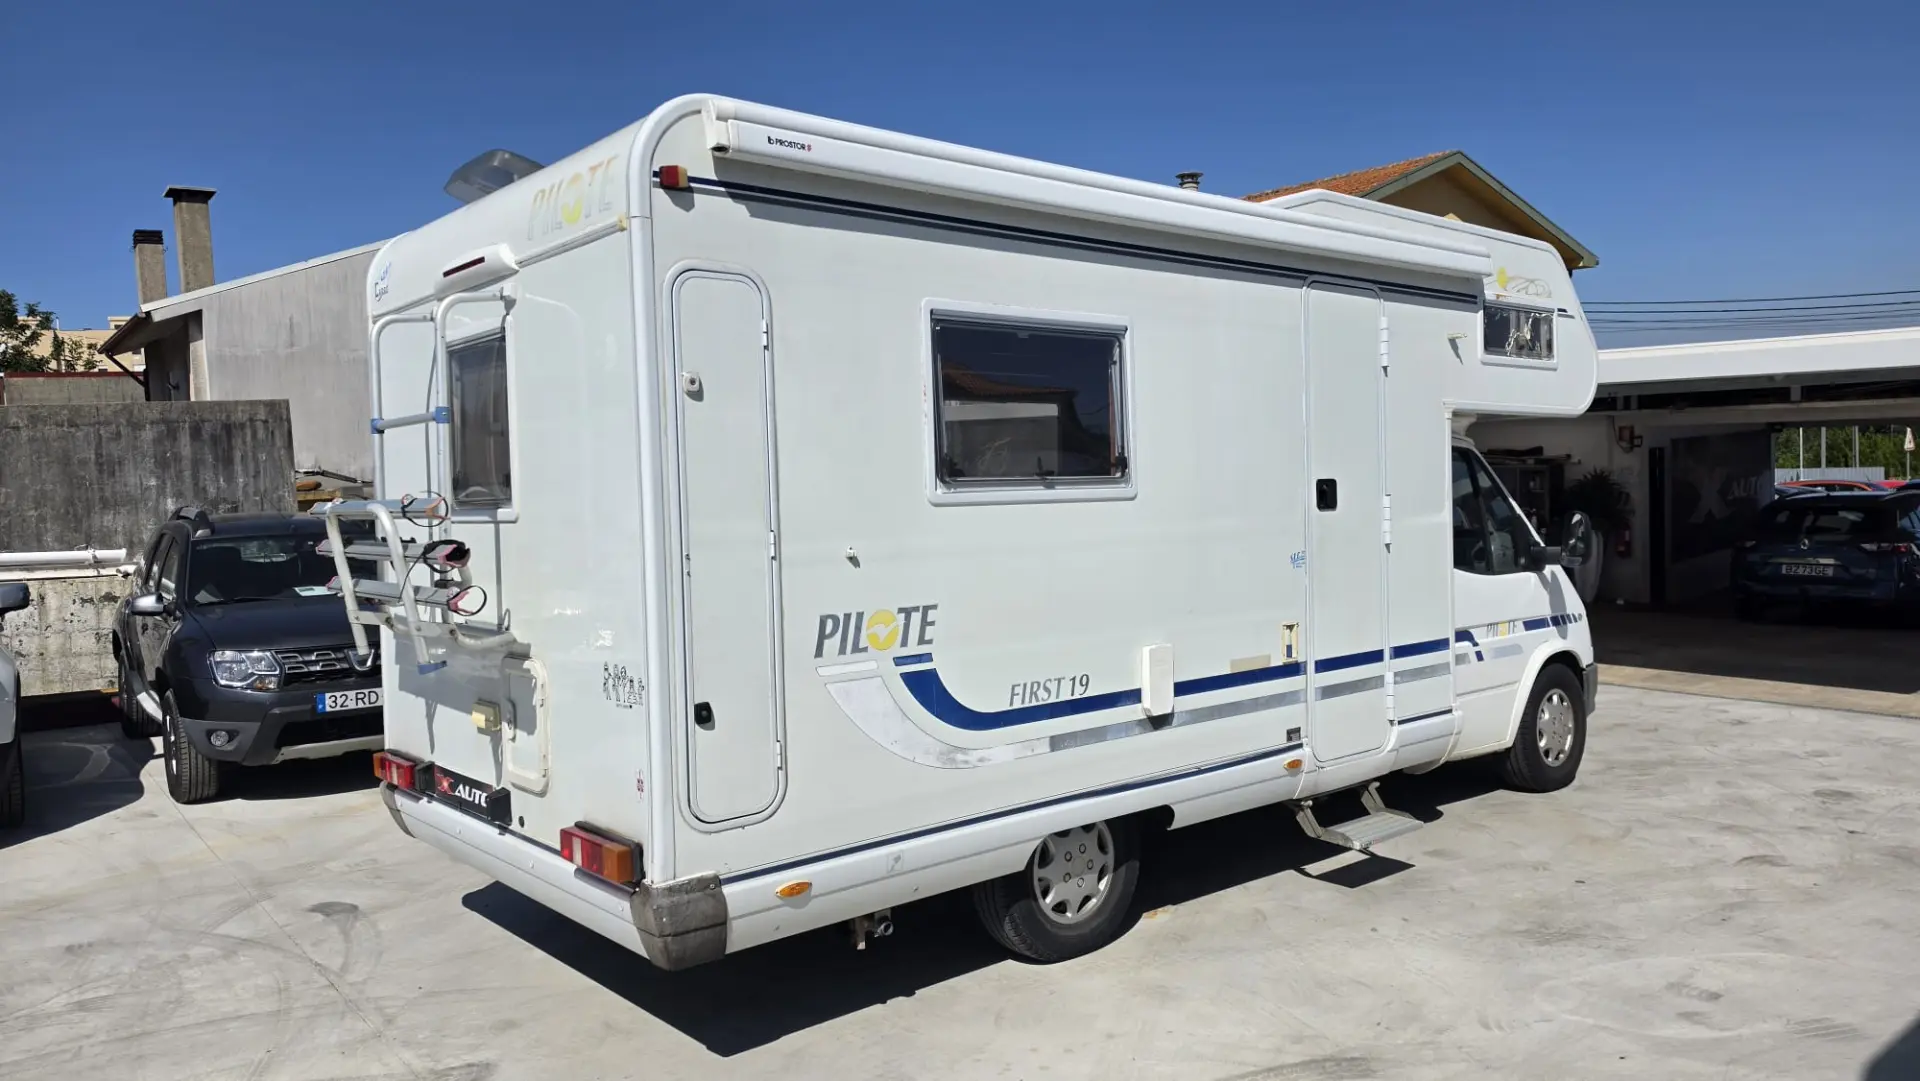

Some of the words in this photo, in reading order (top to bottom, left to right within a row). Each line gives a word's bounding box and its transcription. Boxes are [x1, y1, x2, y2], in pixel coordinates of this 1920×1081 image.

[775, 138, 807, 151] PROSTOR
[527, 154, 618, 241] PILOTE
[814, 603, 938, 659] PILOTE
[1009, 677, 1065, 707] FIRST
[1069, 673, 1090, 697] 19
